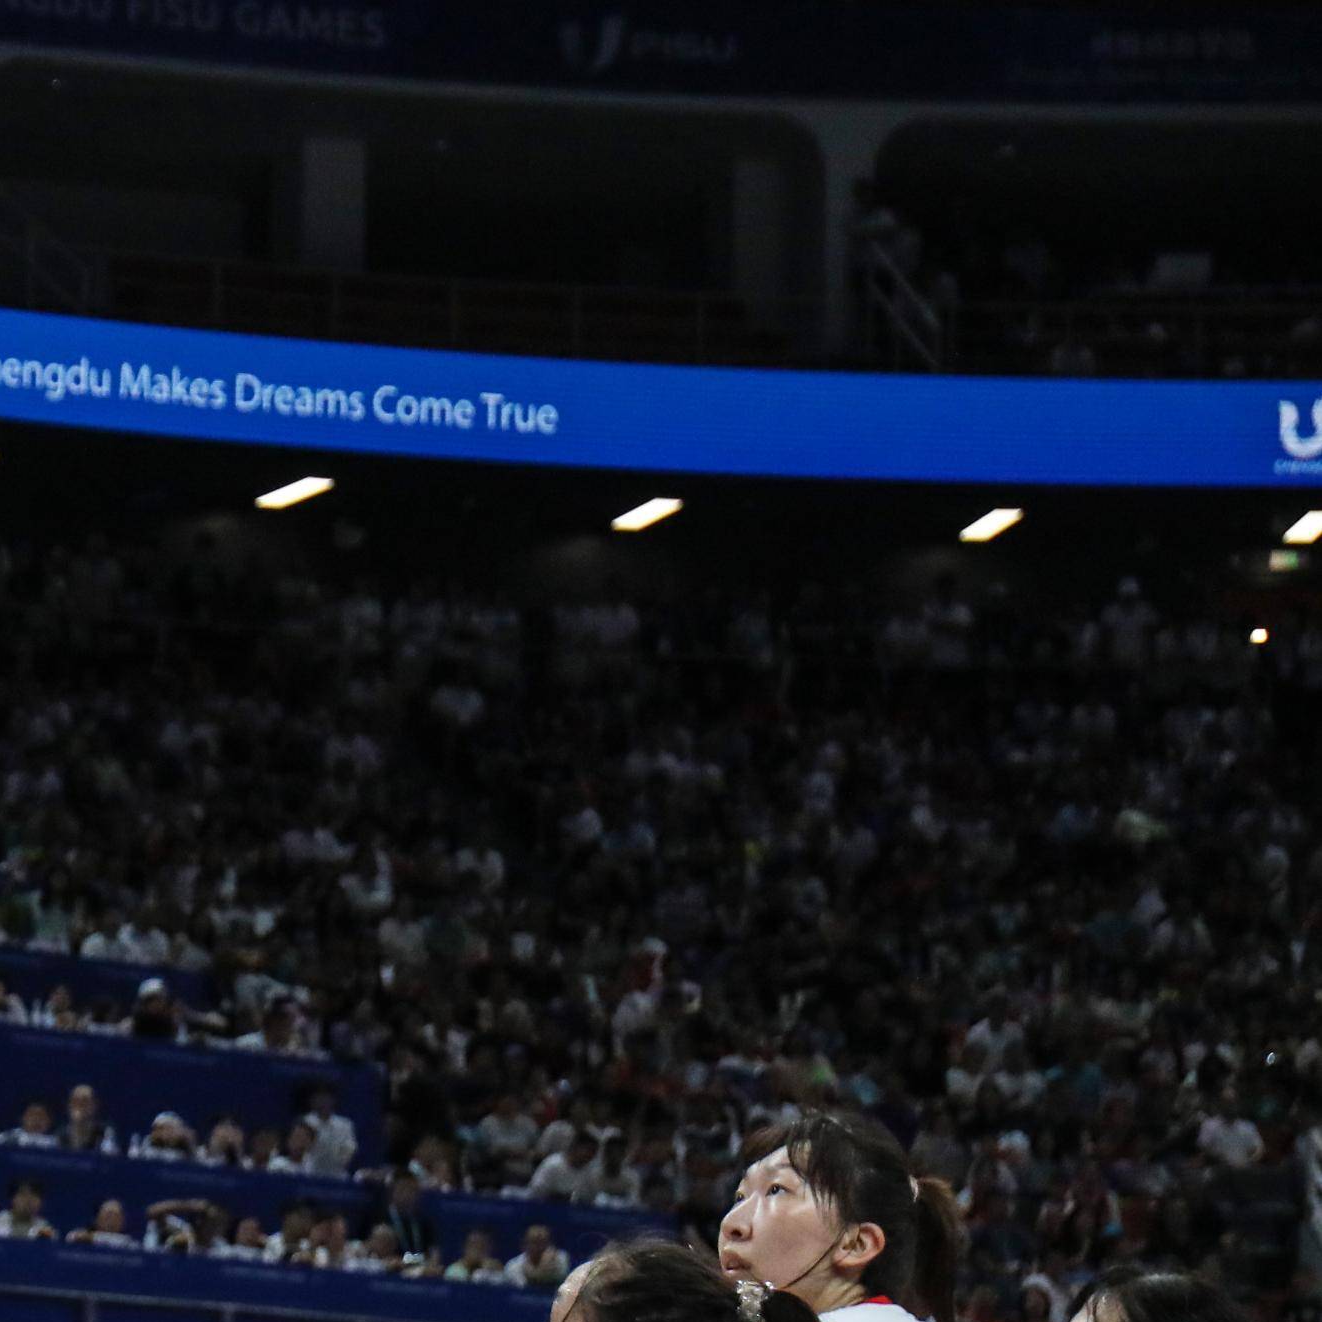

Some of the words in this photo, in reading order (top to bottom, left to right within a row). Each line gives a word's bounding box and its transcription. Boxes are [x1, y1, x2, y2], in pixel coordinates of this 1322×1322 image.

[118, 361, 228, 410] Makes
[234, 372, 366, 422] Dreams
[372, 384, 476, 430] Come
[480, 391, 559, 435] True
